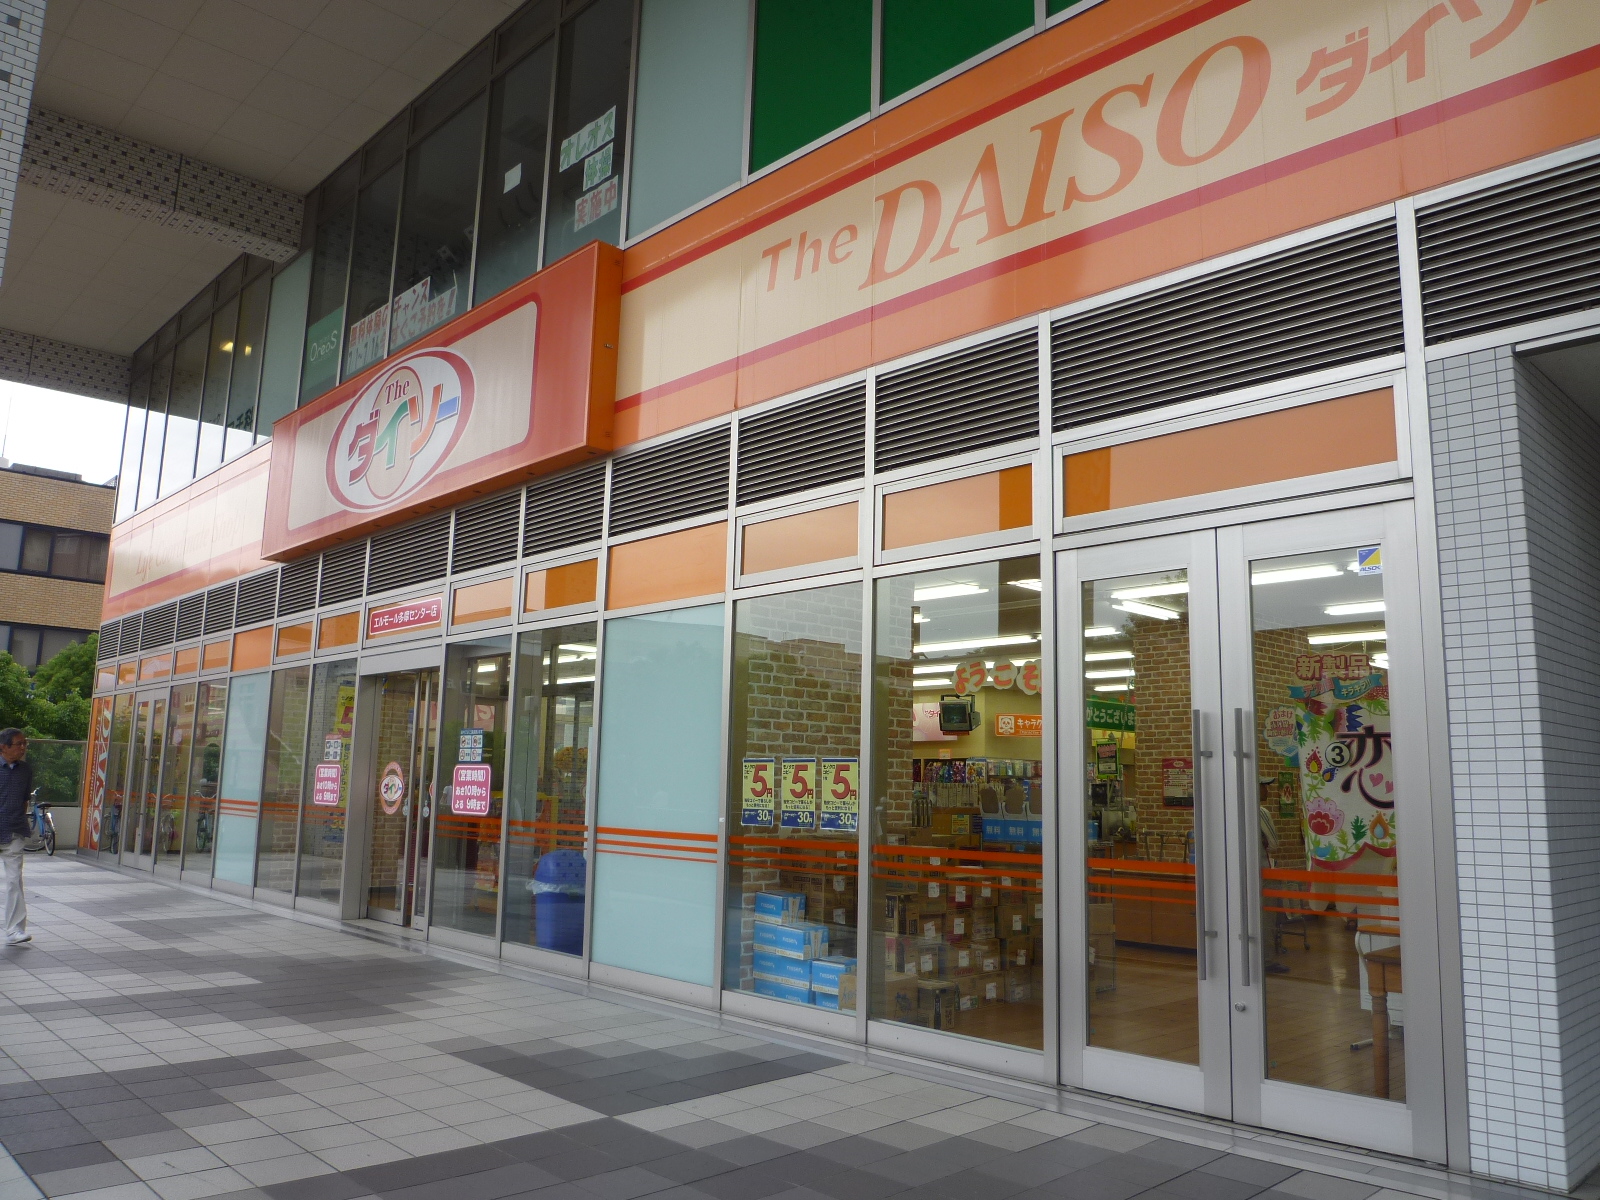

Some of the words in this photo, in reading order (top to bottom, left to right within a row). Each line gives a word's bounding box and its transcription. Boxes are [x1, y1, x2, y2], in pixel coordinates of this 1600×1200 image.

[1296, 0, 1549, 121] ダイソ
[561, 111, 614, 170] オレオス
[585, 146, 612, 185] 体操
[761, 223, 858, 293] The
[858, 35, 1271, 291] DAISO
[577, 181, 617, 226] 実施中
[385, 379, 410, 405] The
[348, 383, 460, 486] ダイソー
[955, 662, 1042, 694] ようこそ
[1296, 655, 1371, 681] 新製品
[1273, 709, 1293, 719] おまけ
[92, 711, 112, 842] DAISO
[455, 786, 487, 797] あさ10時から
[454, 800, 464, 808] よる
[466, 799, 486, 810] 9時まで
[838, 813, 855, 825] 30円
[1008, 826, 1024, 836] 無料
